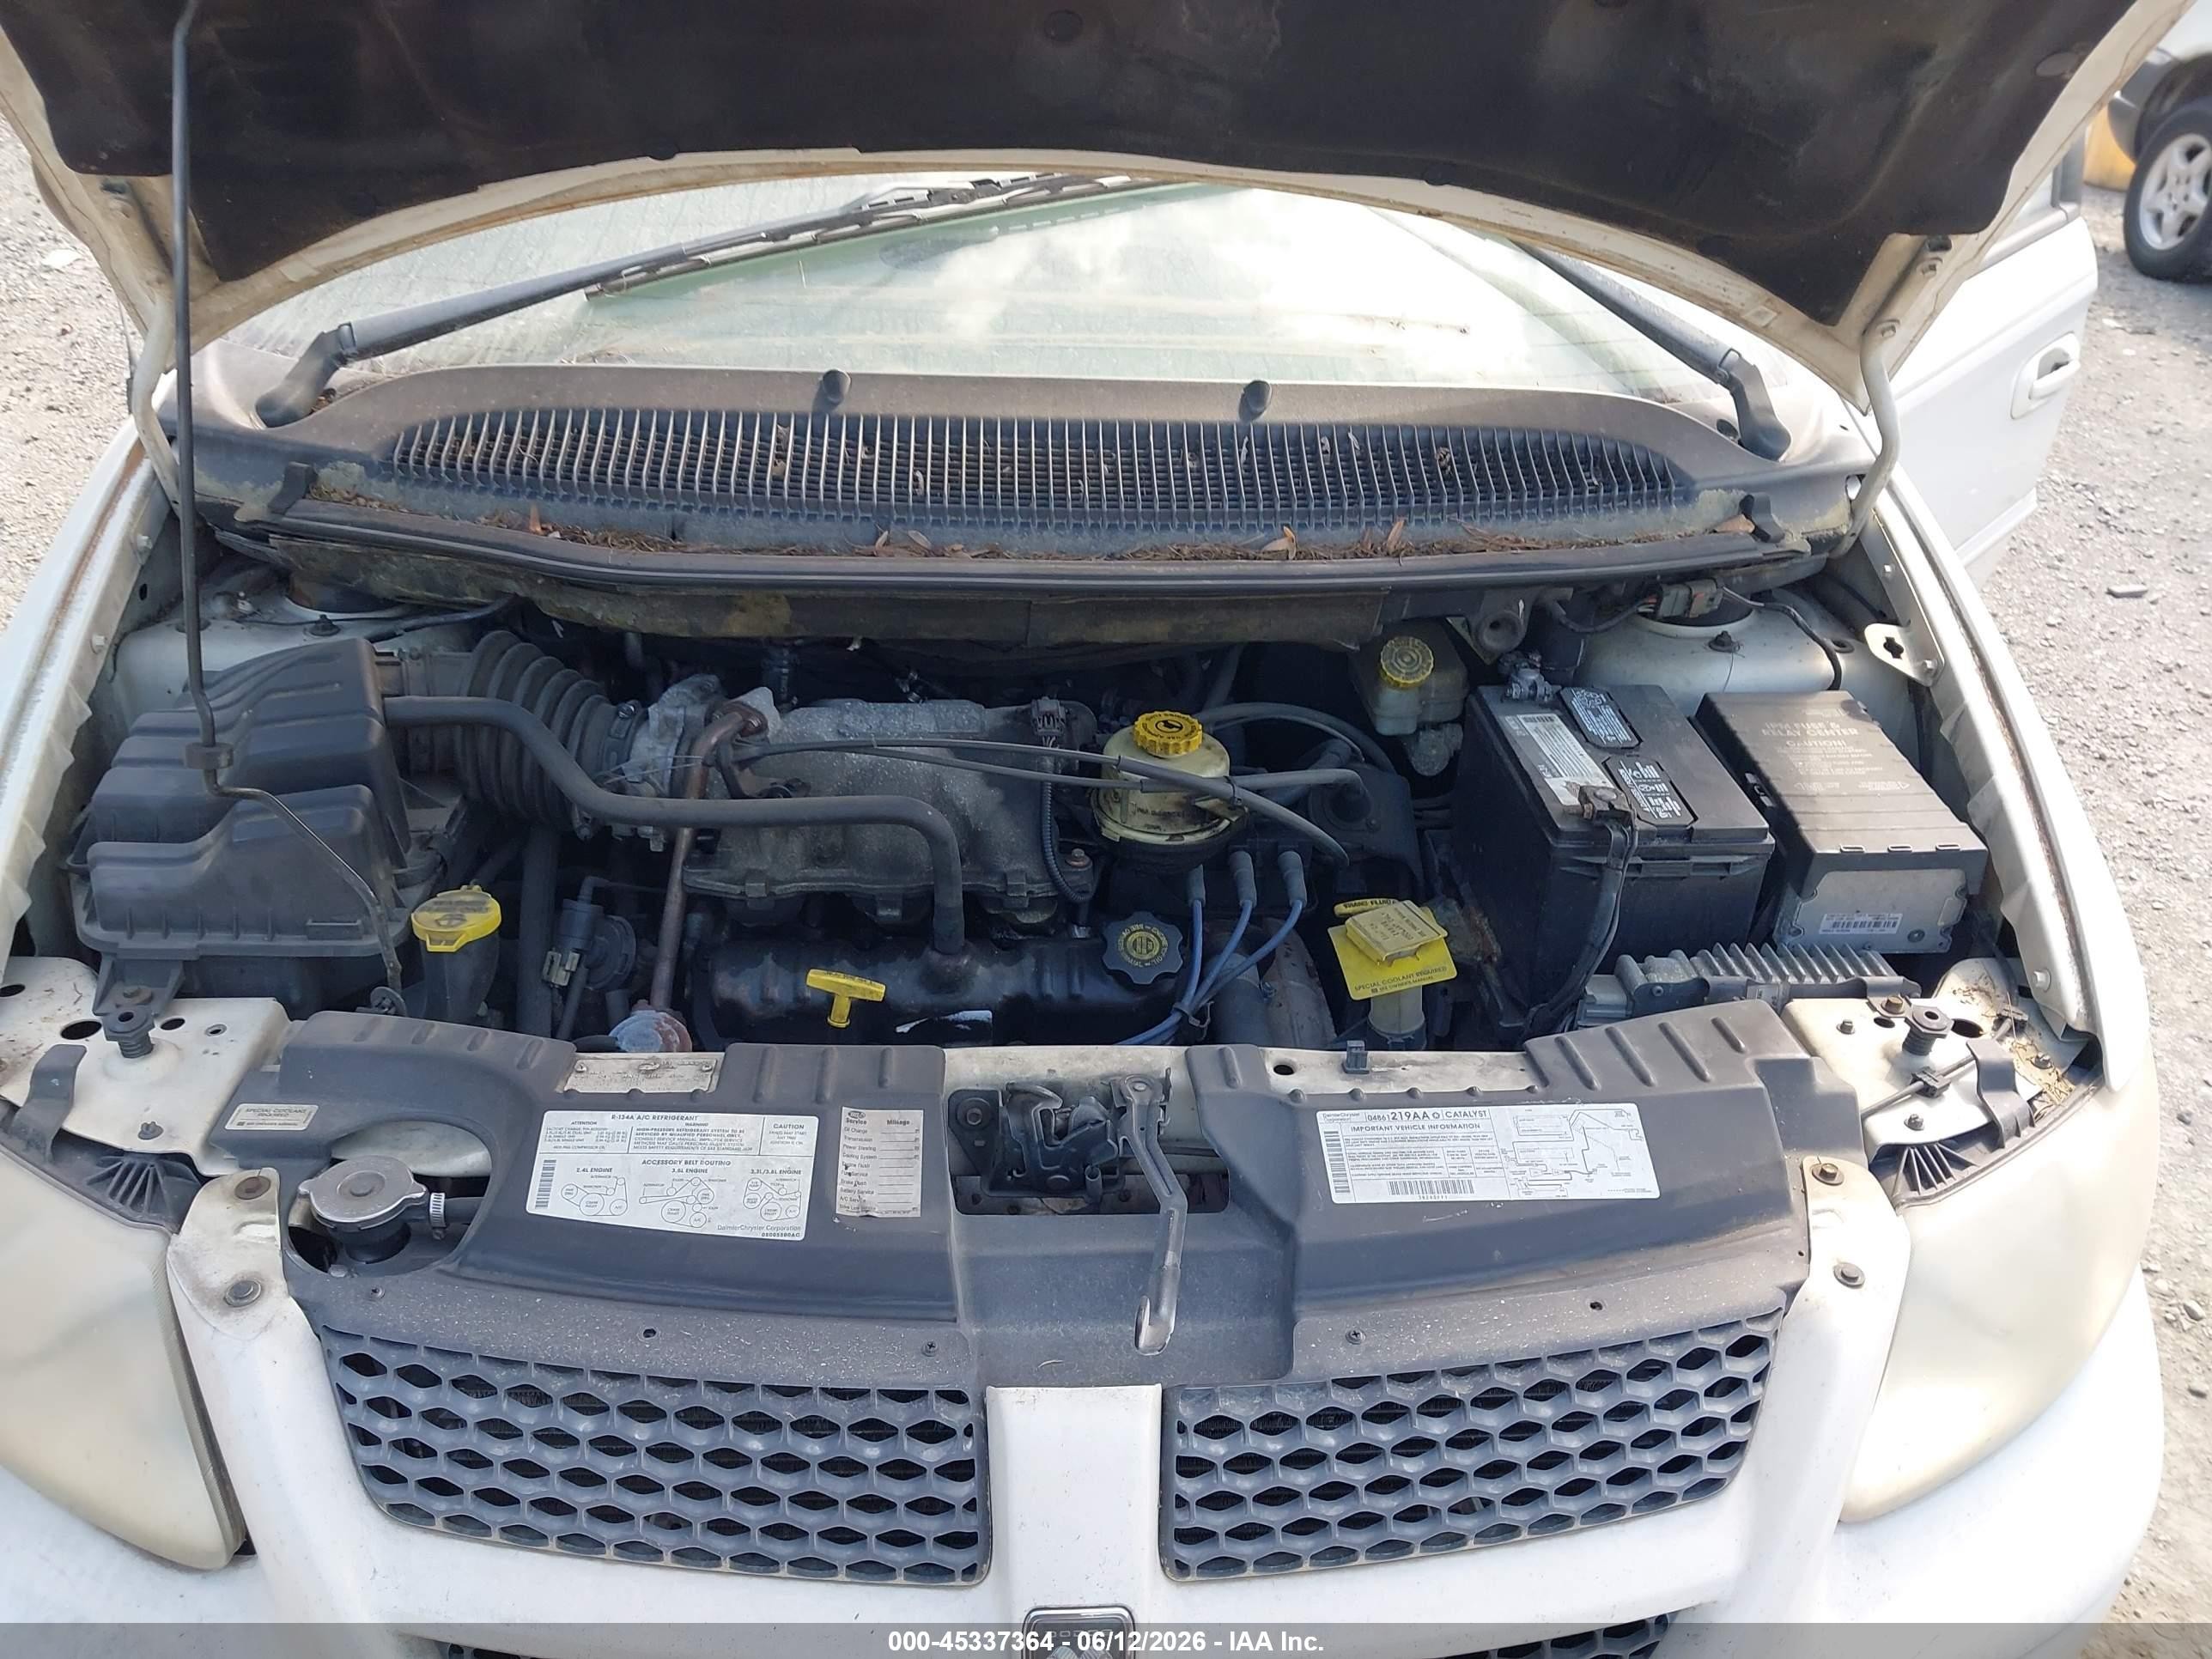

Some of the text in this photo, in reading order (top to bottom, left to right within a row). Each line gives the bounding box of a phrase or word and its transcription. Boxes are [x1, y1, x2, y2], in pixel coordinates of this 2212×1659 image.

[1354, 967, 1447, 991] SPECIAL COOLANT REQUIRED
[1444, 1110, 1487, 1119] CATALYST
